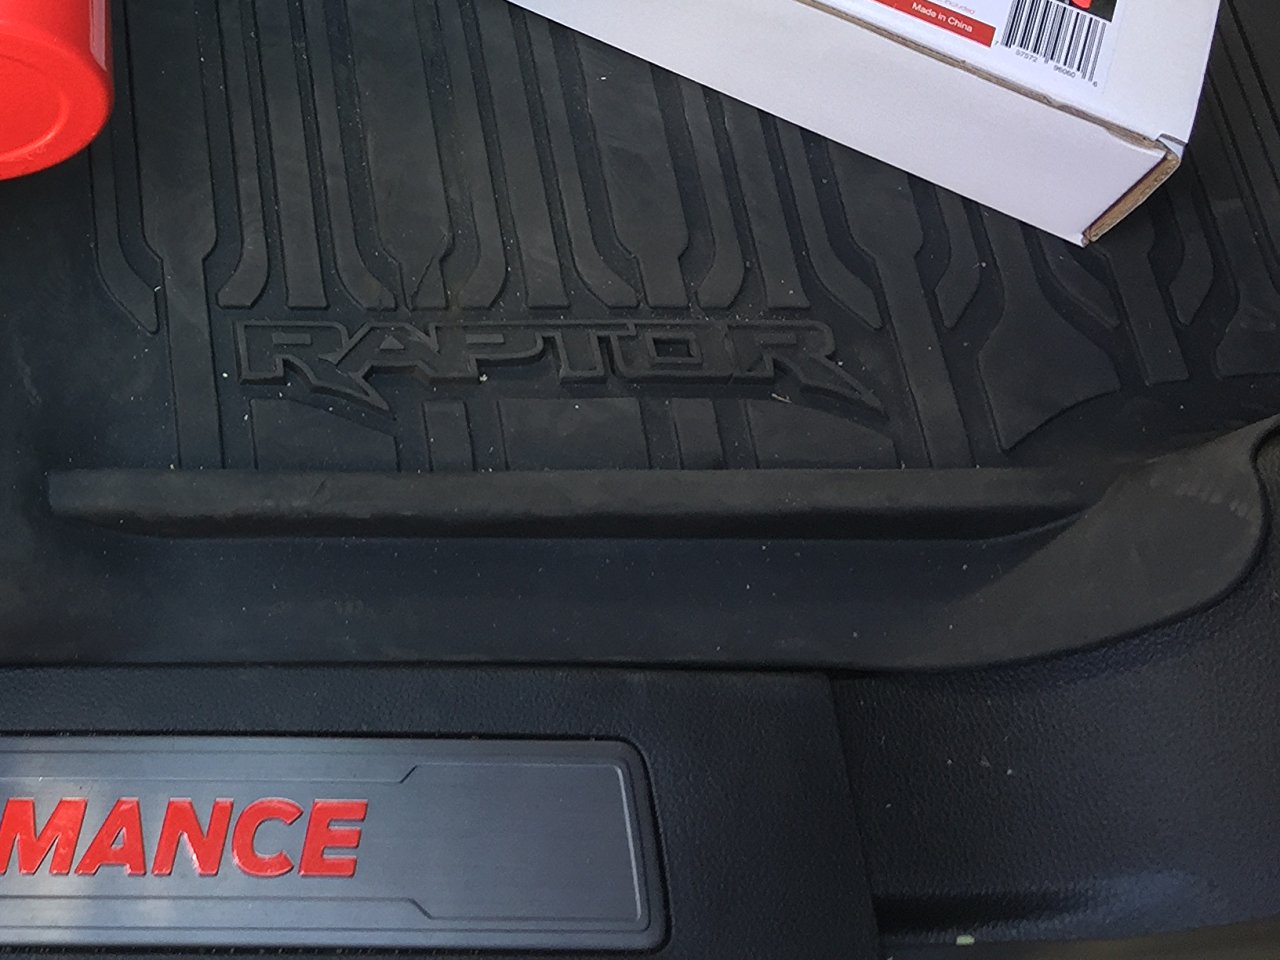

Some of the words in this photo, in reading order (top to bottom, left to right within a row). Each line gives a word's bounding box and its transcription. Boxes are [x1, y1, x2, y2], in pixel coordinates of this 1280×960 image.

[911, 0, 938, 18] Made
[936, 11, 947, 22] in
[946, 14, 973, 33] China
[232, 319, 889, 421] RAPTOR
